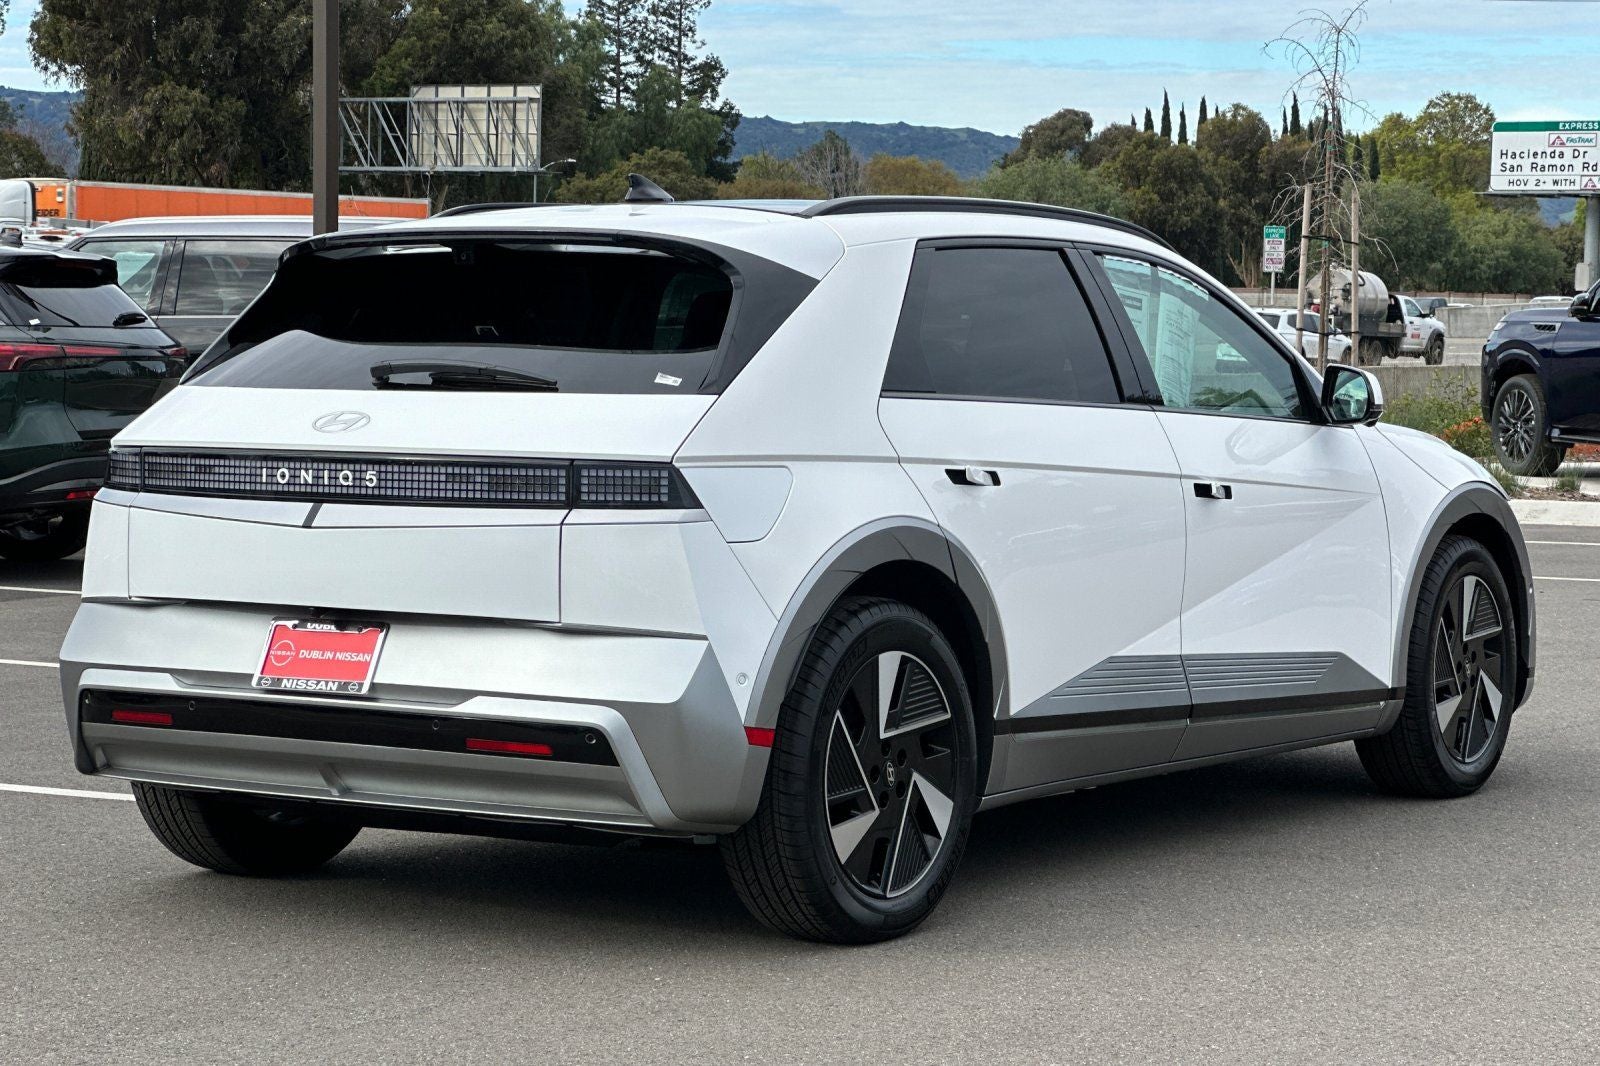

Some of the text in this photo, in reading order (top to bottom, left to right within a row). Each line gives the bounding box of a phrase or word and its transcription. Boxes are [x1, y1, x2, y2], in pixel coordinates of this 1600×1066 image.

[1559, 122, 1599, 130] EXPRESS
[1500, 149, 1588, 160] Hacienda Dr
[1500, 162, 1598, 173] San Ramon Rd
[1508, 178, 1576, 187] HOV 2+ WITH
[298, 649, 372, 662] DUBLIN NISSAN
[280, 678, 339, 691] NISSAN
